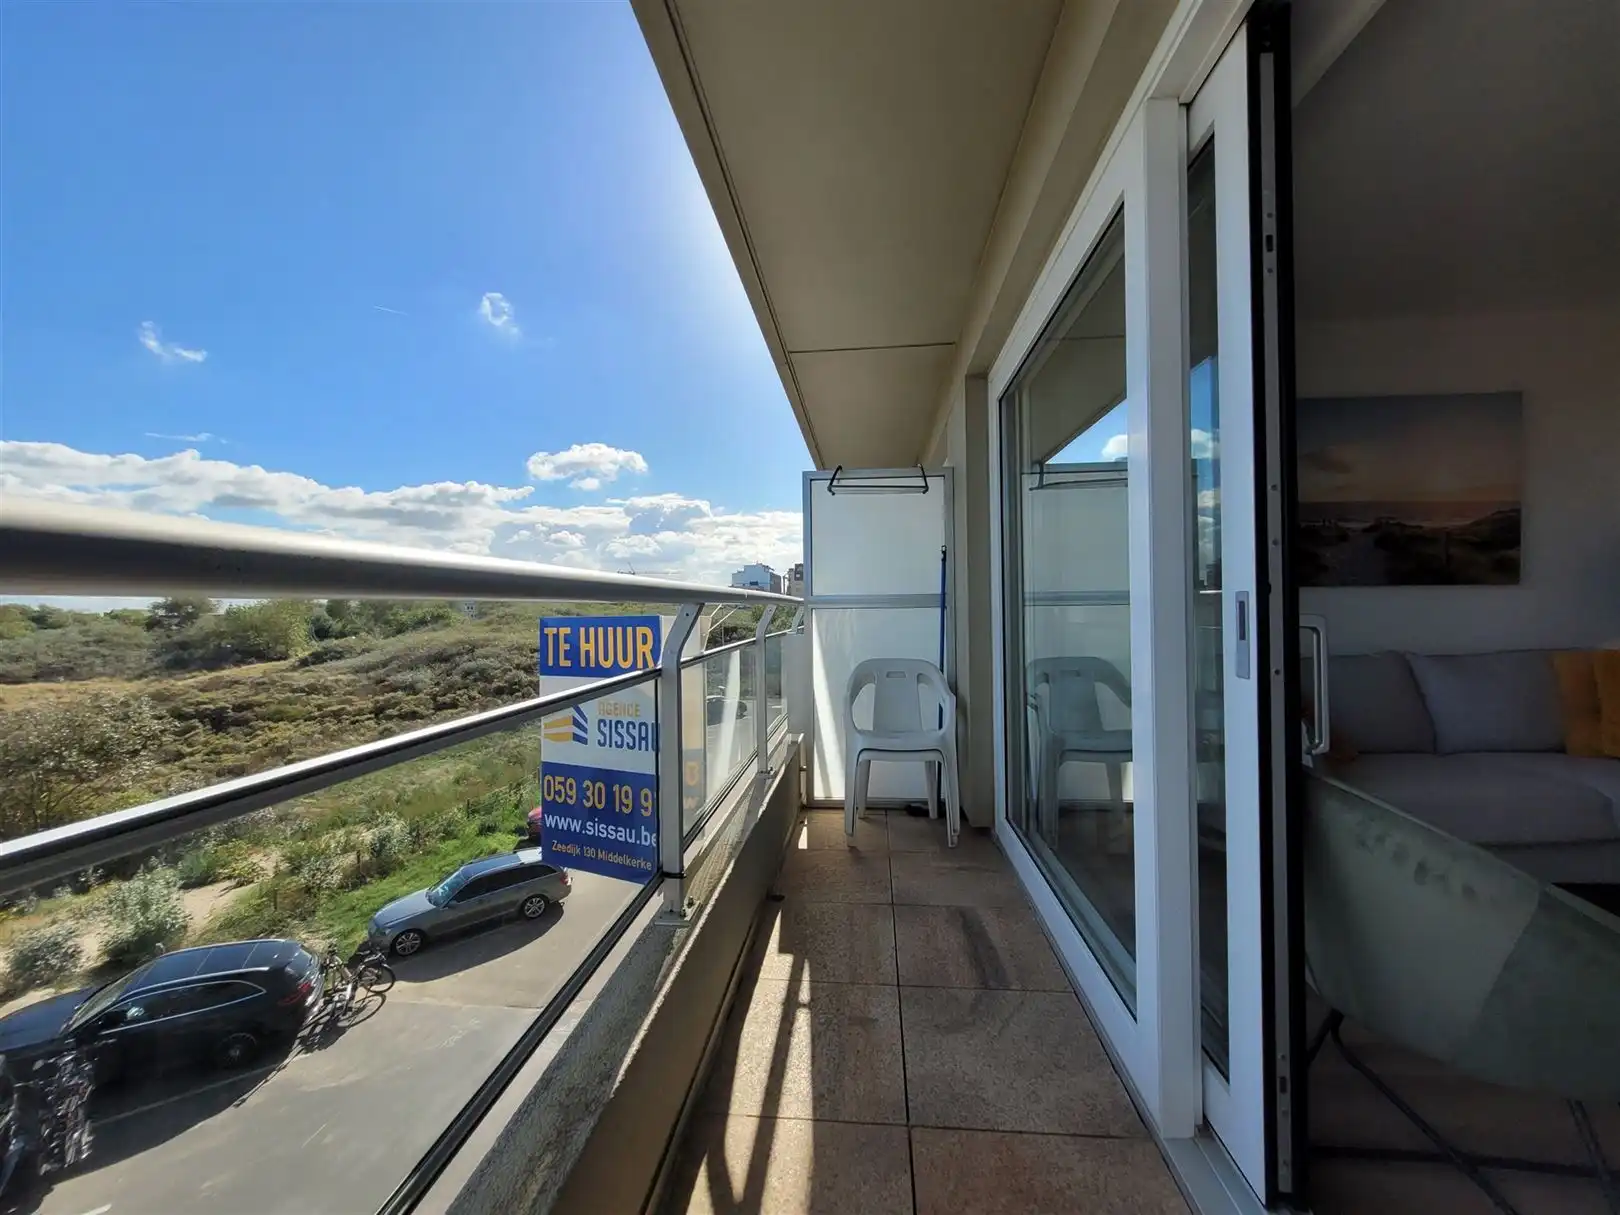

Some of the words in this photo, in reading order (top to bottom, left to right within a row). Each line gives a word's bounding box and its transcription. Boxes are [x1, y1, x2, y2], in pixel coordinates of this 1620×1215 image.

[544, 626, 572, 667] TE
[580, 626, 656, 669] HUUR
[597, 701, 641, 718] AGENCE
[543, 774, 577, 805] 059
[582, 779, 606, 810] 30
[612, 783, 633, 815] 19
[640, 787, 656, 817] 9
[544, 813, 657, 848] www.sissau.be
[551, 839, 581, 857] Zeedijk
[583, 845, 596, 859] 130
[597, 847, 652, 871] Middelkerke
